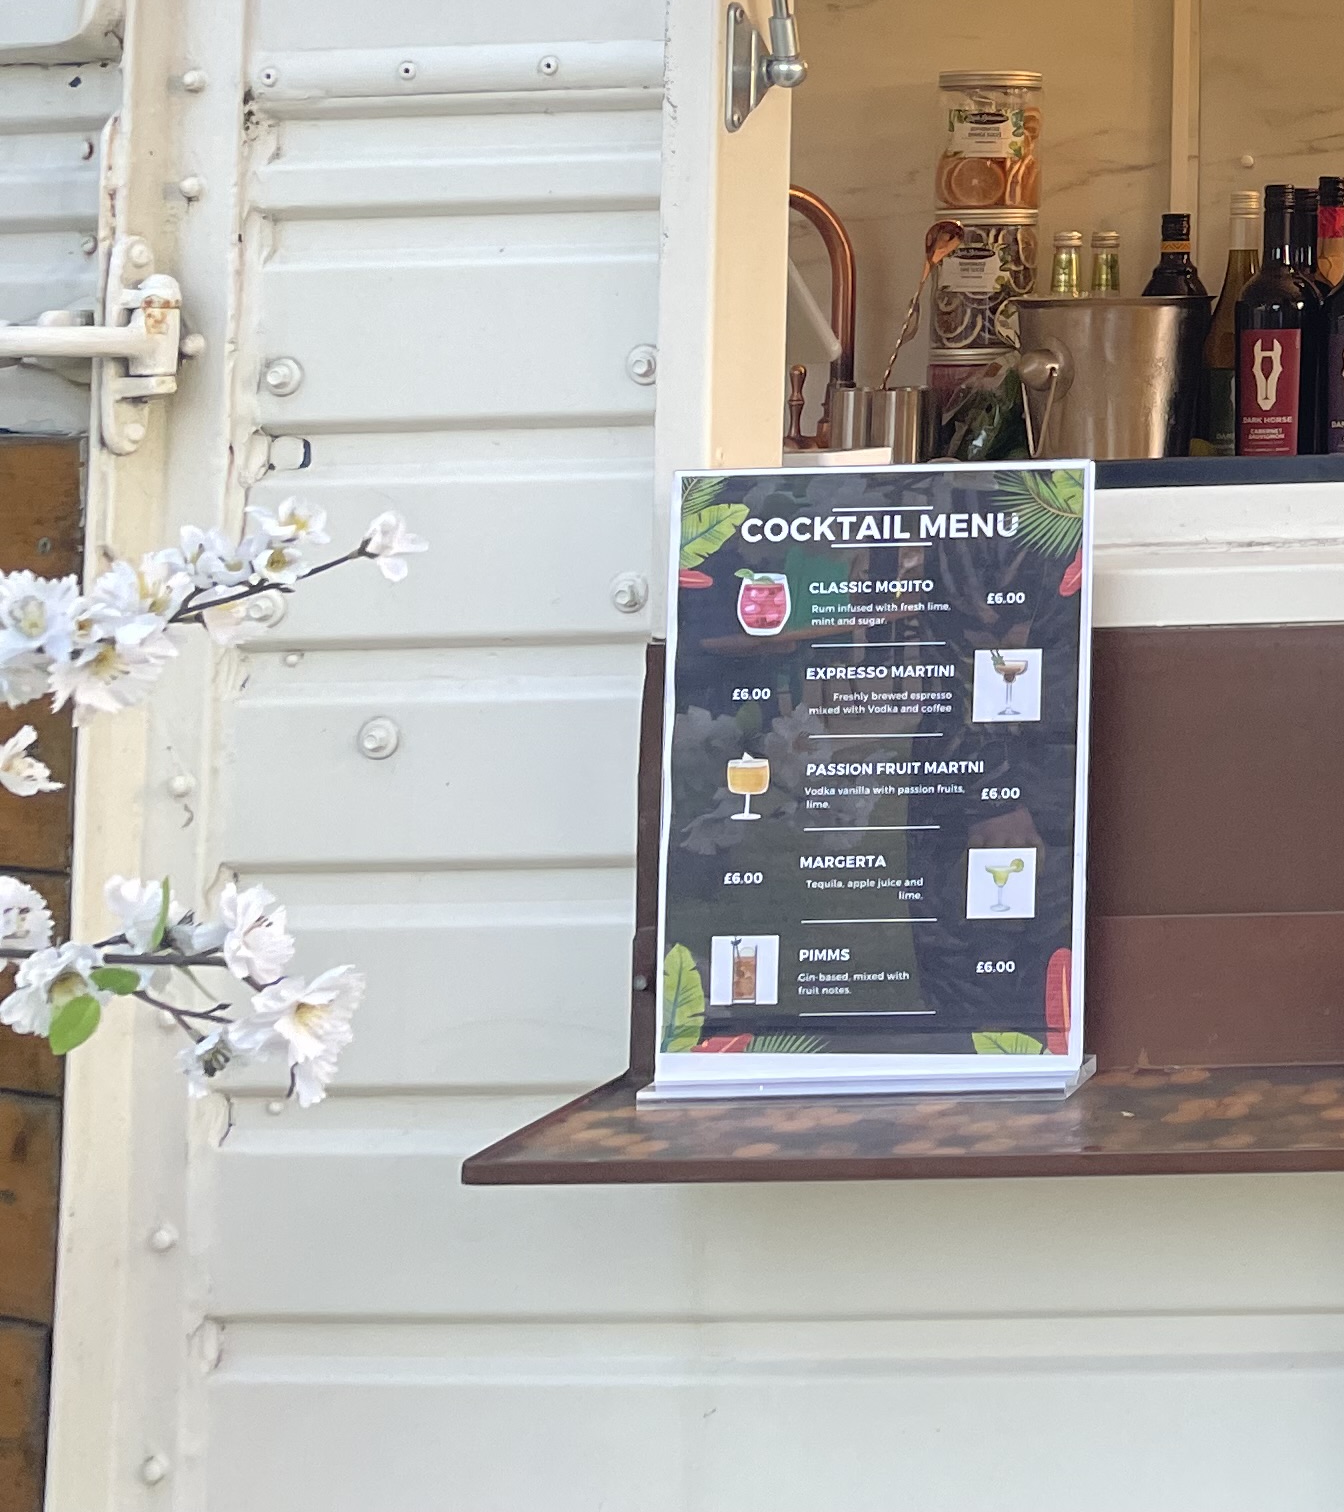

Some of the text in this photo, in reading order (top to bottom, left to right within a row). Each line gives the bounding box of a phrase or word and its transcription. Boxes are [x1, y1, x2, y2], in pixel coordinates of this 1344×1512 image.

[1242, 416, 1263, 424] DARK
[741, 512, 1019, 543] COCKTAIL MENU
[809, 579, 934, 595] CLASSIC MOJITO
[986, 592, 1026, 605] £6.00
[811, 604, 836, 614] Rum
[838, 603, 874, 614] infused
[875, 602, 898, 612] with
[900, 601, 925, 612] fresh
[811, 616, 887, 628] mint and sugar.
[806, 664, 955, 681] EXPRESSO MARTINI
[732, 688, 771, 701] £6.00
[833, 691, 952, 703] Freshly brewed espresso
[808, 703, 952, 716] mixed with Vodka and coffee
[806, 760, 984, 776] PASSION FRUIT MARTNI
[804, 786, 836, 796] Vodka
[838, 786, 870, 796] vanilla
[872, 785, 895, 795] with
[897, 785, 935, 797] passion
[981, 787, 1020, 800] £6.00
[800, 855, 887, 869] MARGERTA
[723, 872, 763, 885] £6.00
[847, 879, 875, 890] apple
[877, 878, 902, 889] juice
[903, 878, 924, 887] and
[799, 949, 850, 962] PIMMS
[975, 961, 1016, 974] £6.00
[853, 972, 885, 982] mixed
[886, 971, 910, 981] with
[798, 986, 852, 995] fruit notes.
